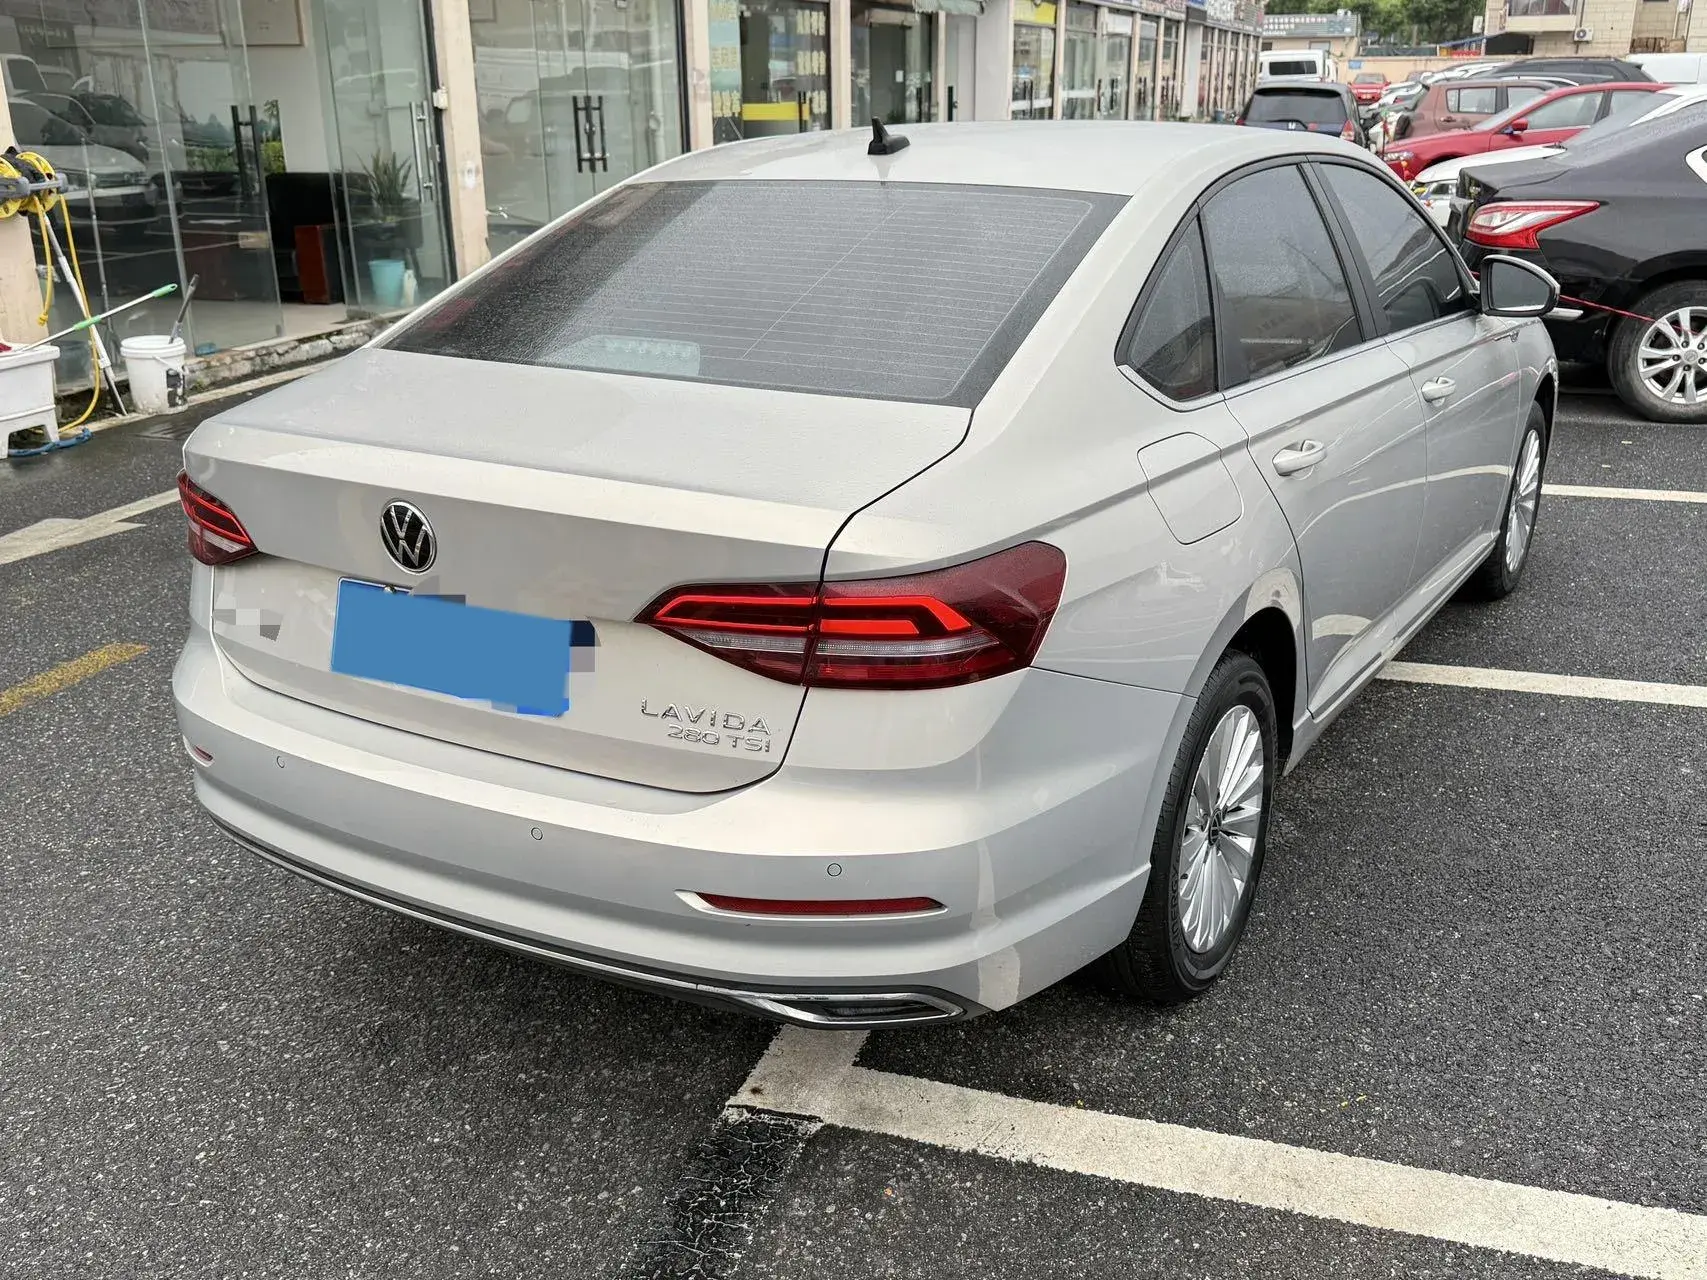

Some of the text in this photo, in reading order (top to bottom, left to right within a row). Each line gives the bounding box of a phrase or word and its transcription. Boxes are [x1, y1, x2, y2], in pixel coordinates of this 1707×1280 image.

[640, 698, 771, 735] LAVIDA
[667, 723, 770, 752] 280 TSI
